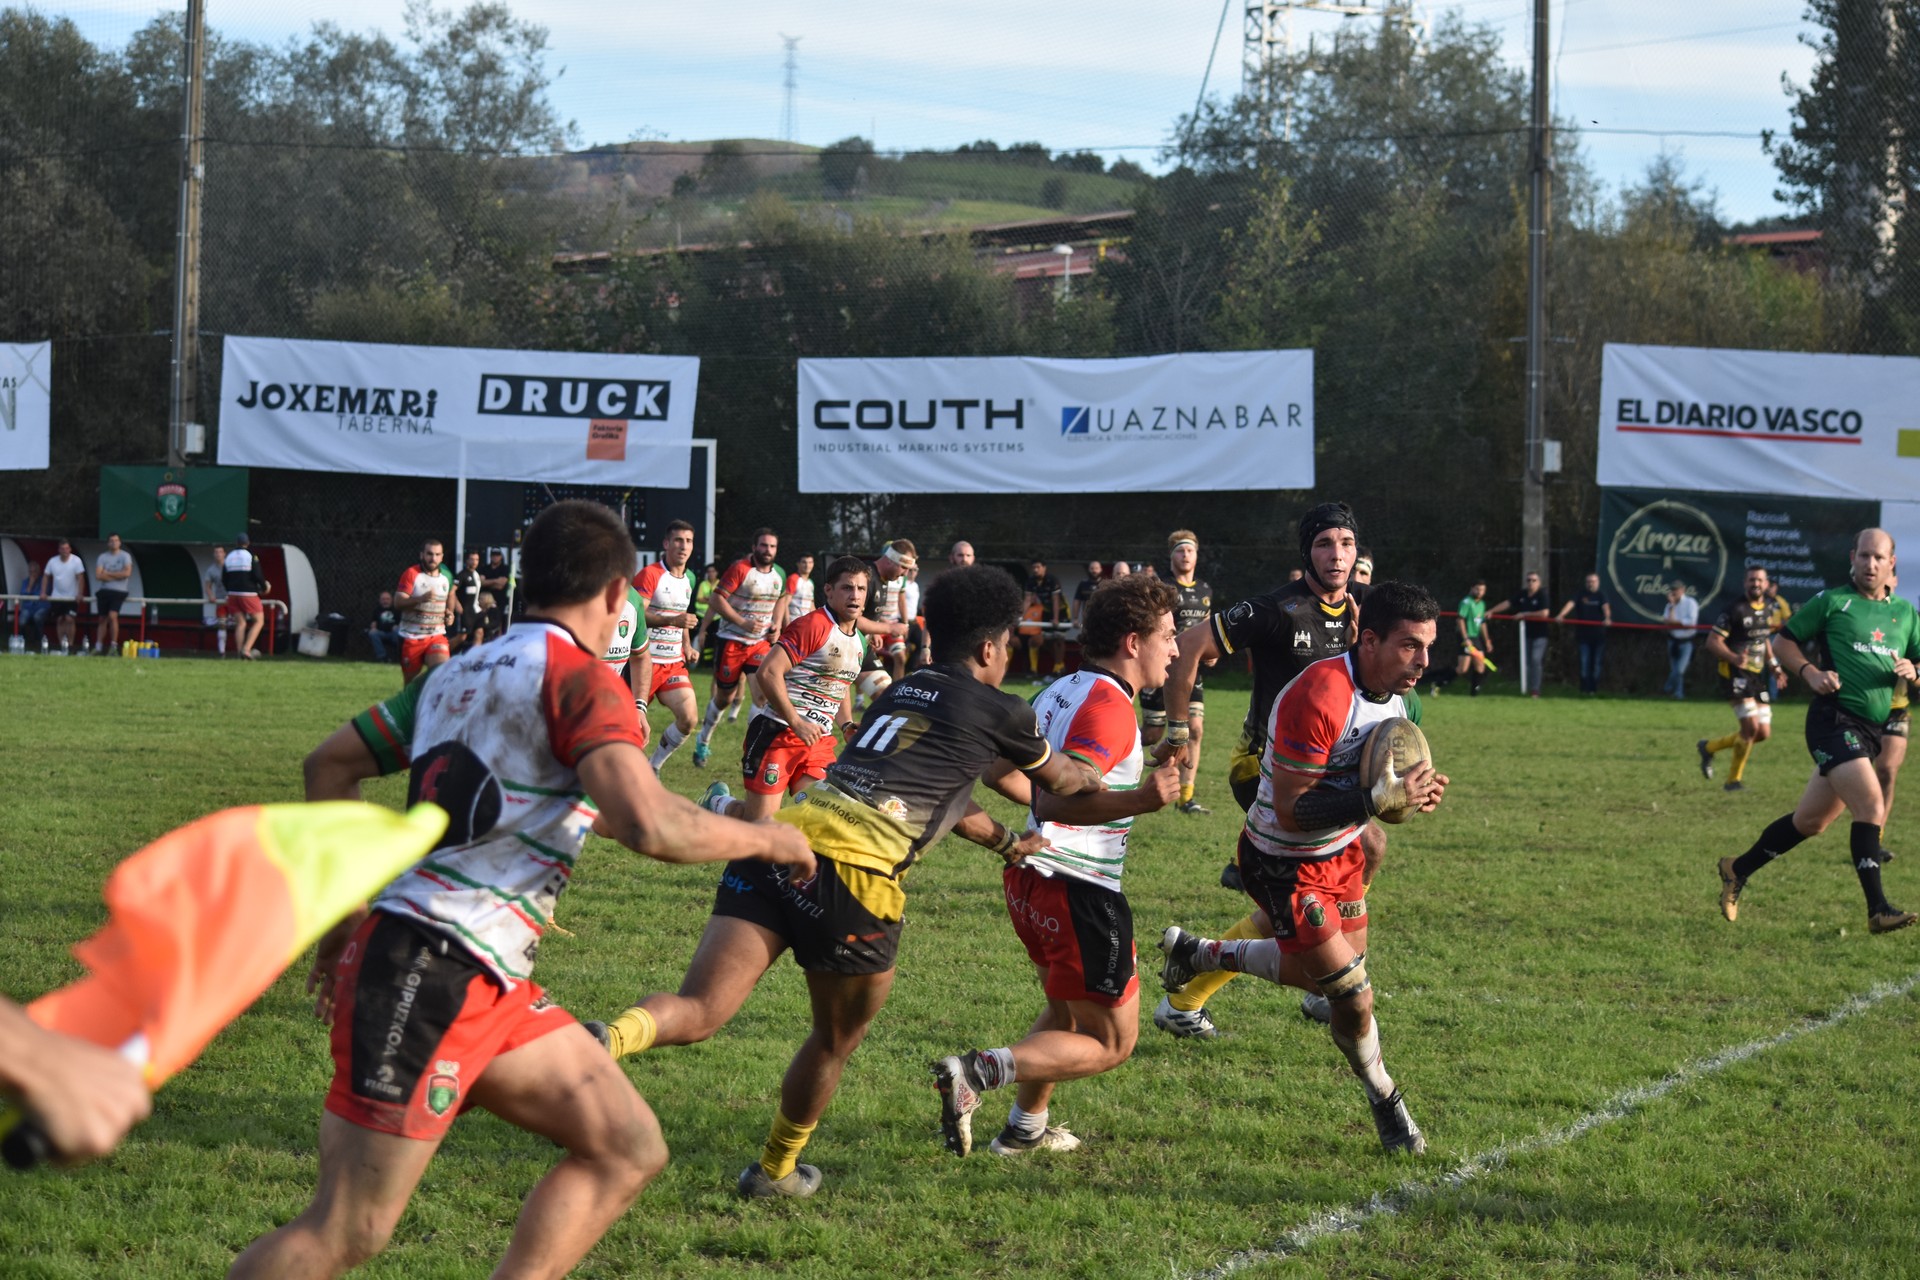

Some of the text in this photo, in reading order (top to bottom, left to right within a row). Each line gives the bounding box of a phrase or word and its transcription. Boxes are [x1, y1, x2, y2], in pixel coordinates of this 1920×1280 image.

[483, 378, 665, 417] DRUCK
[814, 398, 1024, 430] COUTH
[337, 413, 434, 435] TABERNA
[1616, 398, 1863, 434] EL DIARIO VASCO
[814, 442, 1025, 454] INDUSTRIAL MARKING SYSTEMS
[1619, 524, 1711, 555] Aroza
[856, 714, 909, 752] 11
[810, 797, 861, 827] Ural Motor
[1109, 929, 1120, 974] GIPUZKOA
[382, 972, 422, 1056] GIPUZKOA
